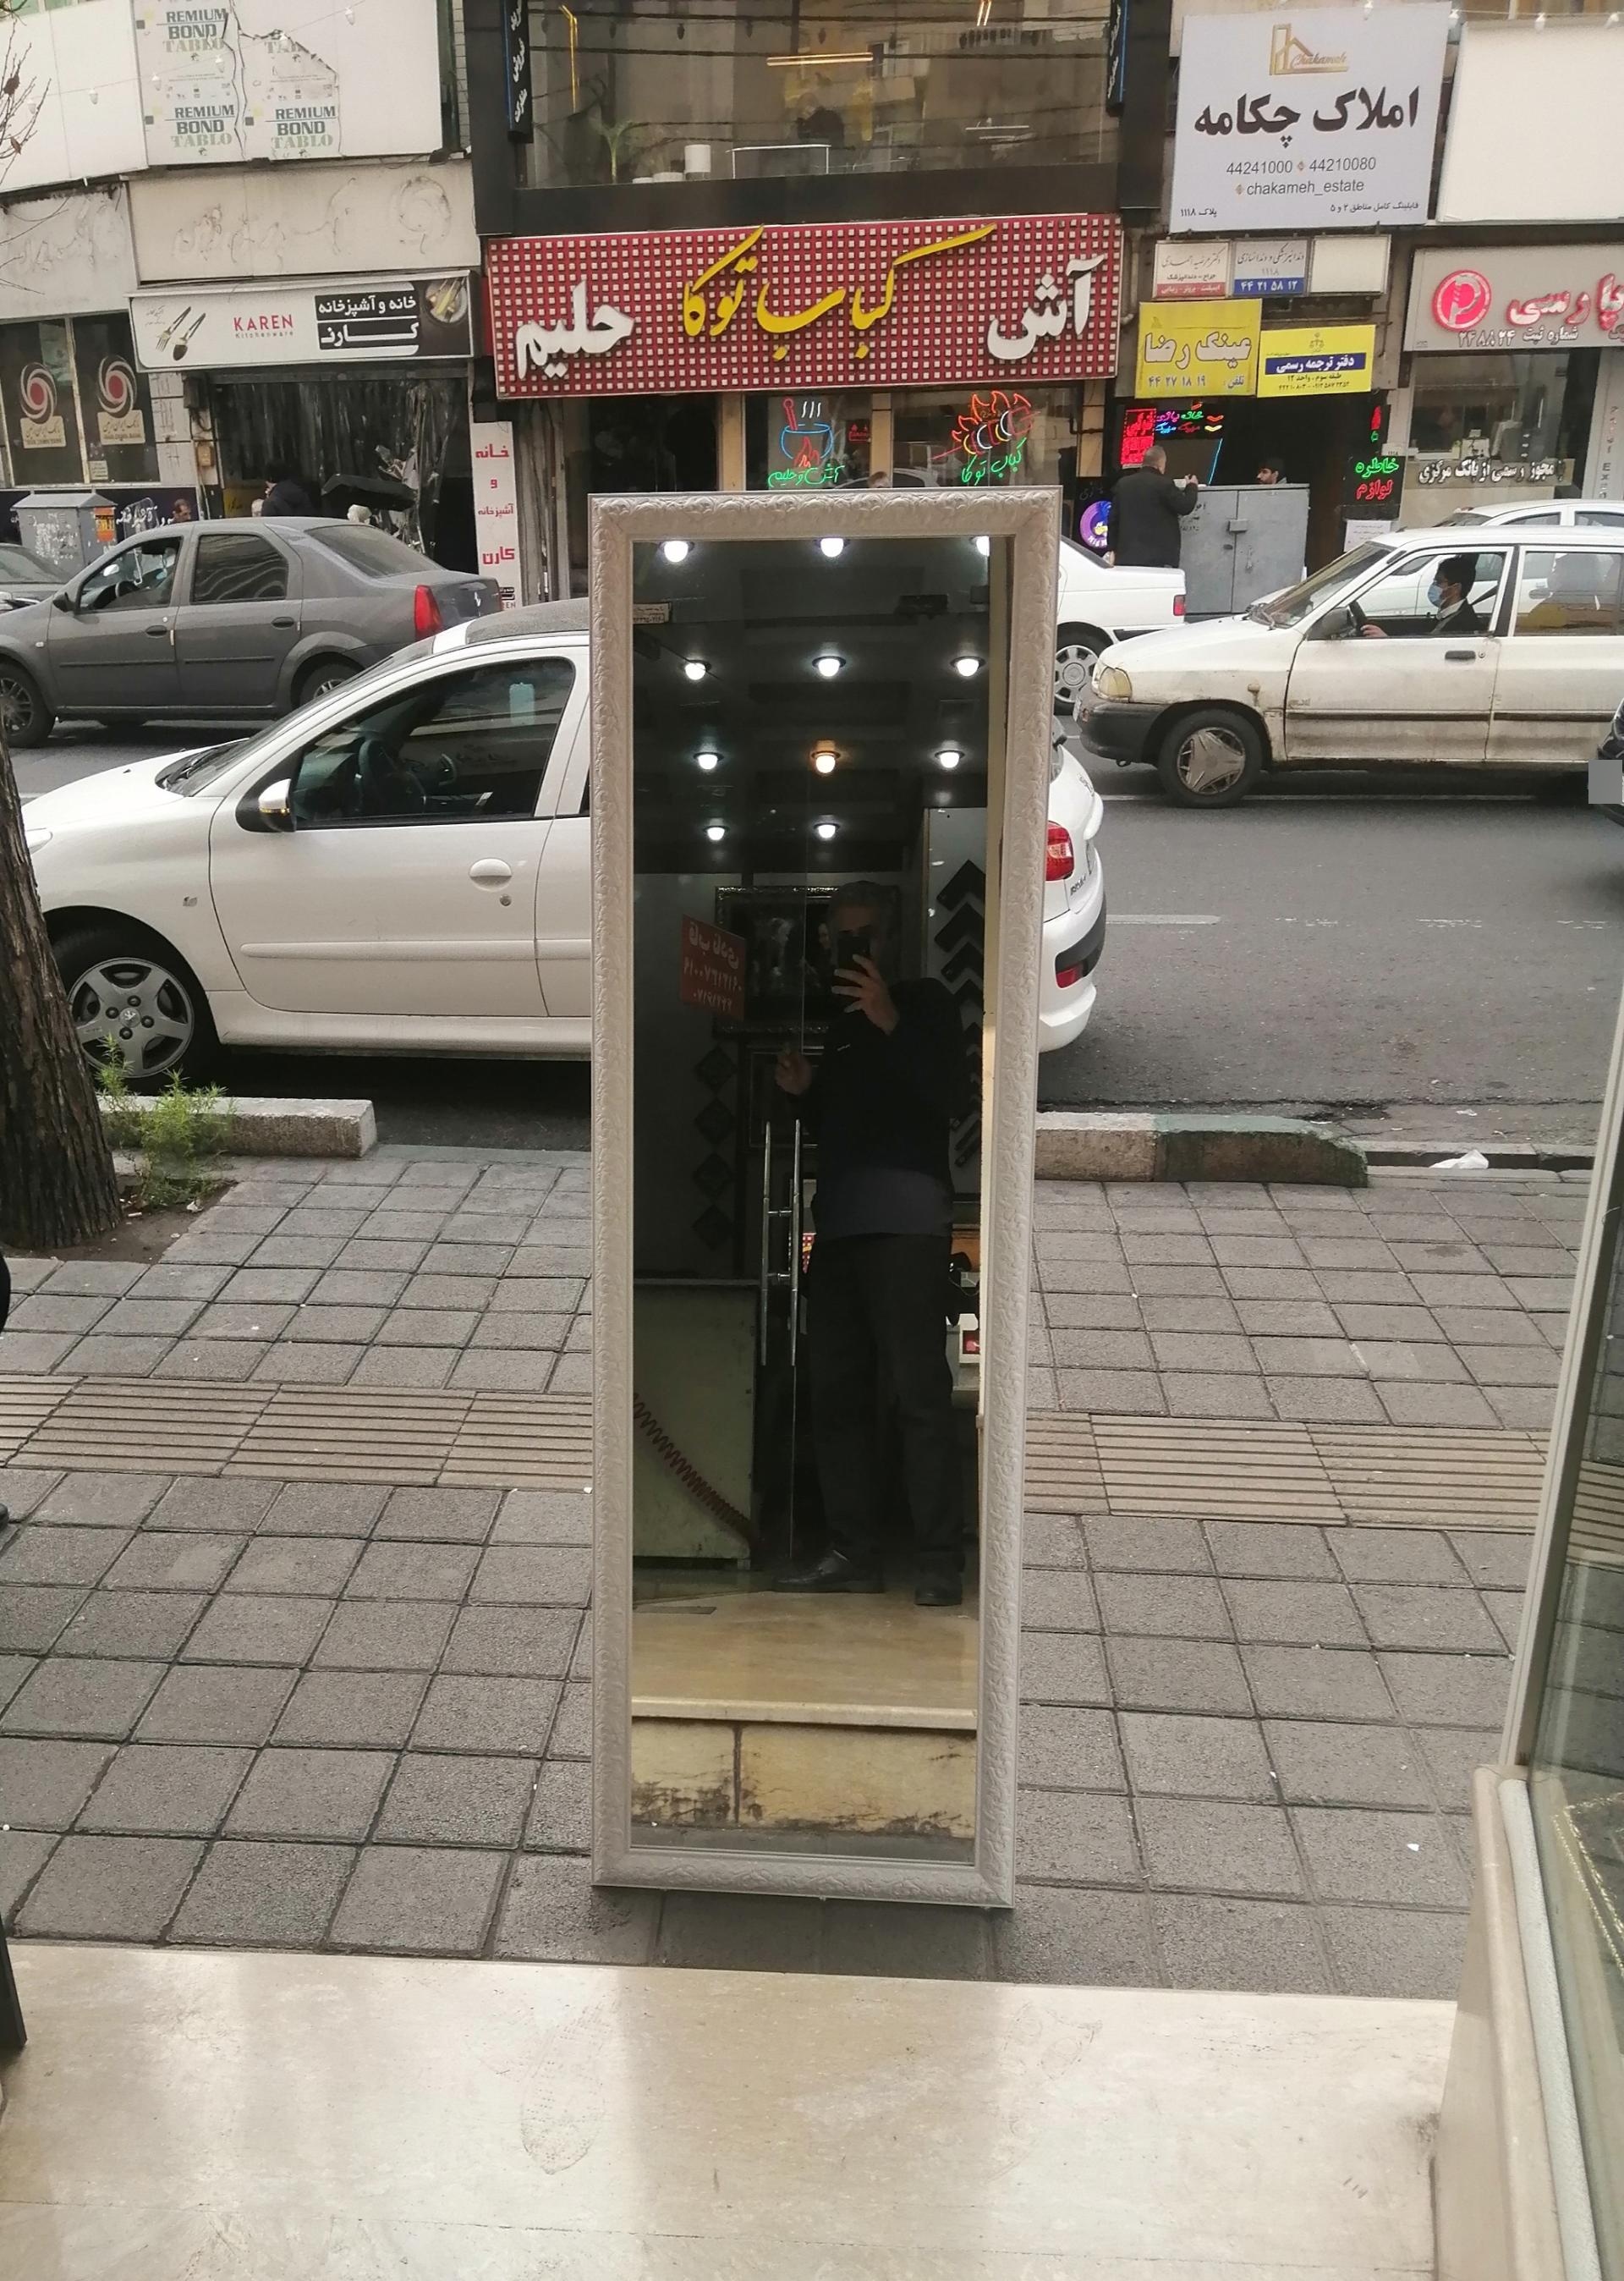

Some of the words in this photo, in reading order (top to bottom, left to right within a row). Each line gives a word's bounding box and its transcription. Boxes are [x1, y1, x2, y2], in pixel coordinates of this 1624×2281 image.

[166, 8, 228, 23] REMIUM
[168, 24, 217, 40] BOND
[174, 105, 234, 118] REMIUM
[275, 106, 337, 120] REMIUM
[1313, 85, 1419, 132] املاک
[176, 119, 225, 135] BOND
[277, 120, 326, 136] BOND
[1194, 93, 1301, 148] چکامه
[170, 133, 233, 148] TABLO
[271, 134, 334, 149] TABLO
[1226, 160, 1293, 175] 44241000
[1309, 157, 1376, 172] 44210080
[1247, 180, 1364, 196] chakameh_estate
[682, 223, 765, 337] توکا
[1270, 280, 1284, 291] ۵۸
[756, 223, 998, 363] کباب
[318, 294, 376, 317] آشپزخانه
[379, 300, 386, 314] و
[389, 295, 417, 311] خانه
[987, 252, 1106, 361] آش
[233, 314, 294, 331] KAREN
[514, 280, 634, 381] حلیم
[1144, 332, 1191, 370] رضا
[1195, 331, 1252, 369] عینک
[1276, 360, 1303, 374] رسمی
[1305, 356, 1334, 371] ترجمه
[1334, 354, 1355, 371] دفتر
[475, 443, 510, 459] خانه
[990, 437, 1027, 478] کباب
[1355, 457, 1400, 478] خاطره
[490, 478, 498, 489] و
[478, 503, 514, 519] آشپزخانه
[482, 546, 516, 565] کارن
